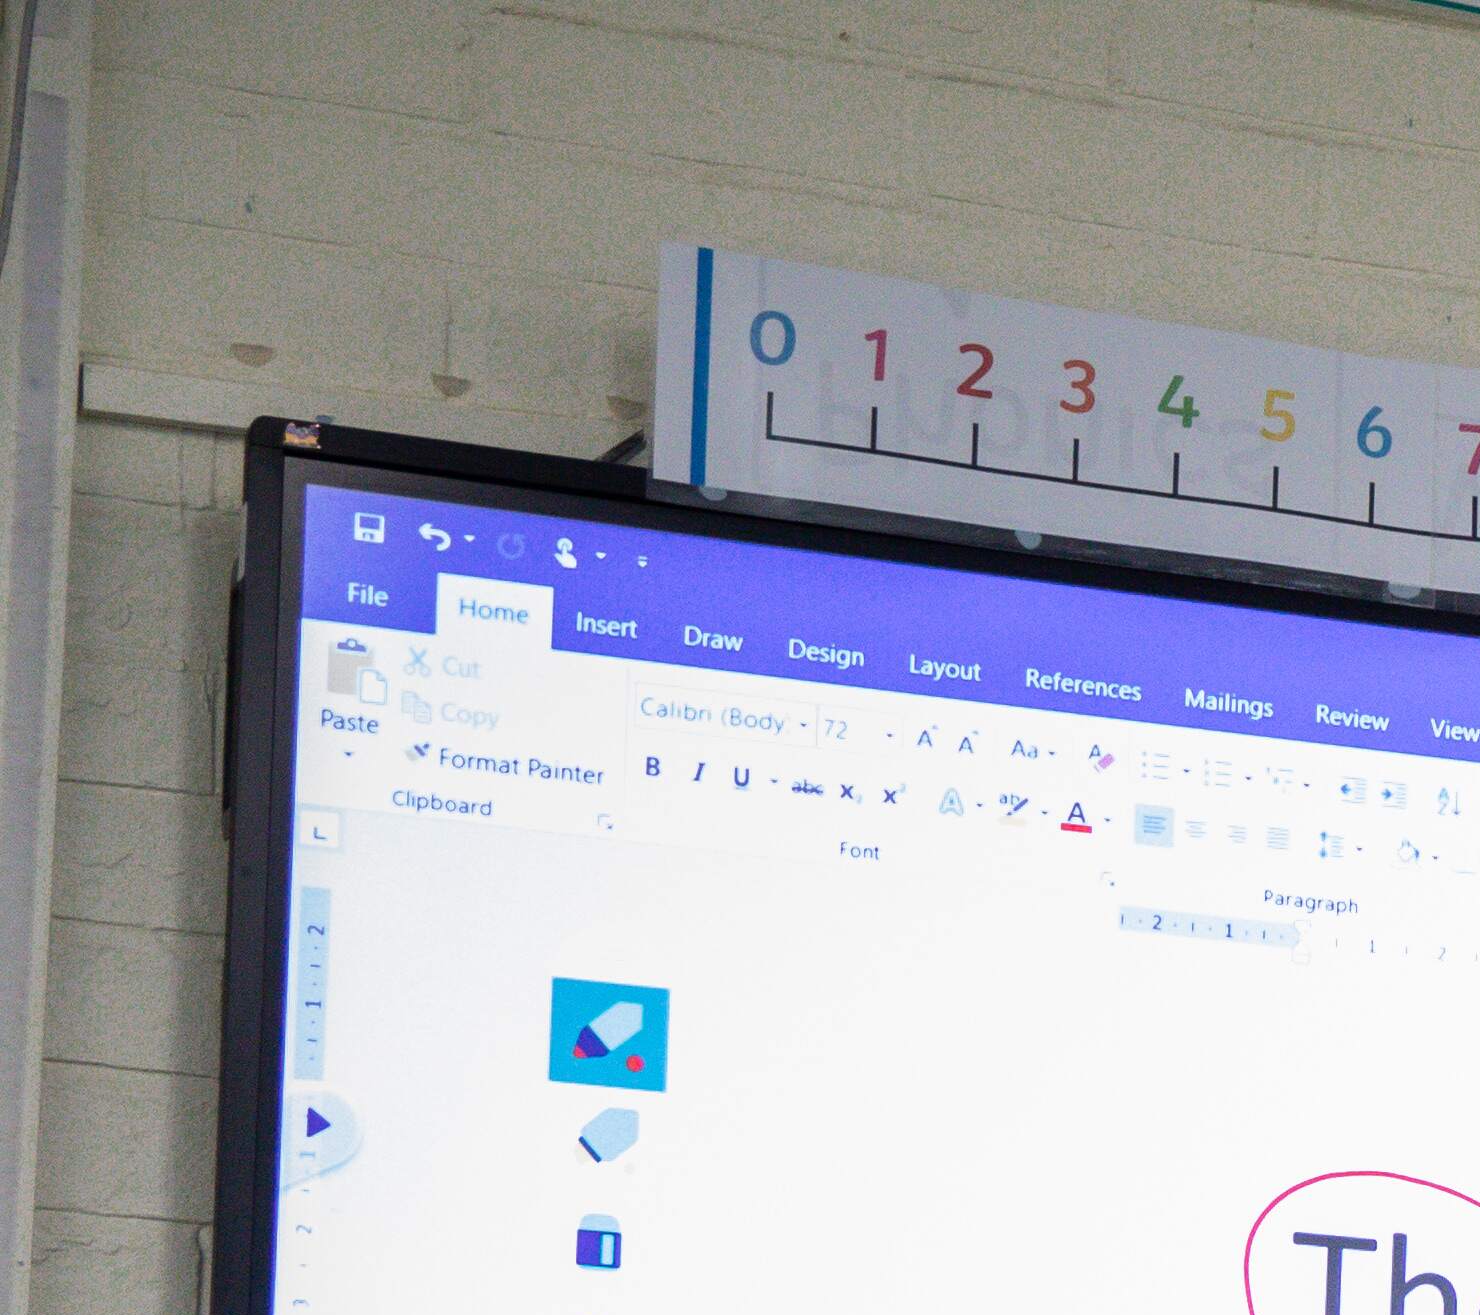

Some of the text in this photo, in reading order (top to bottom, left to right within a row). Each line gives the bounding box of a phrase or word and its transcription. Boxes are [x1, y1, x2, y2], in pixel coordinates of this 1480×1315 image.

[749, 310, 797, 366] 0
[864, 329, 888, 382] 1
[956, 343, 994, 400] 2
[1059, 359, 1096, 414] 3
[1157, 374, 1200, 429] 4
[1259, 388, 1296, 443] 5
[1356, 405, 1393, 459] 6
[347, 581, 389, 607] File
[459, 598, 529, 625] Home
[576, 611, 638, 639] Insert
[683, 625, 744, 652] Draw
[788, 638, 865, 670] Design
[909, 653, 982, 682] Layout
[1025, 667, 1142, 702] References
[1184, 687, 1274, 721] Mailings
[1315, 703, 1390, 731] Review
[1430, 718, 1480, 743] View
[320, 708, 379, 734] Paste
[438, 746, 604, 784] Format Painter
[392, 790, 493, 817] Clipboard
[1263, 889, 1359, 916] Paragraph
